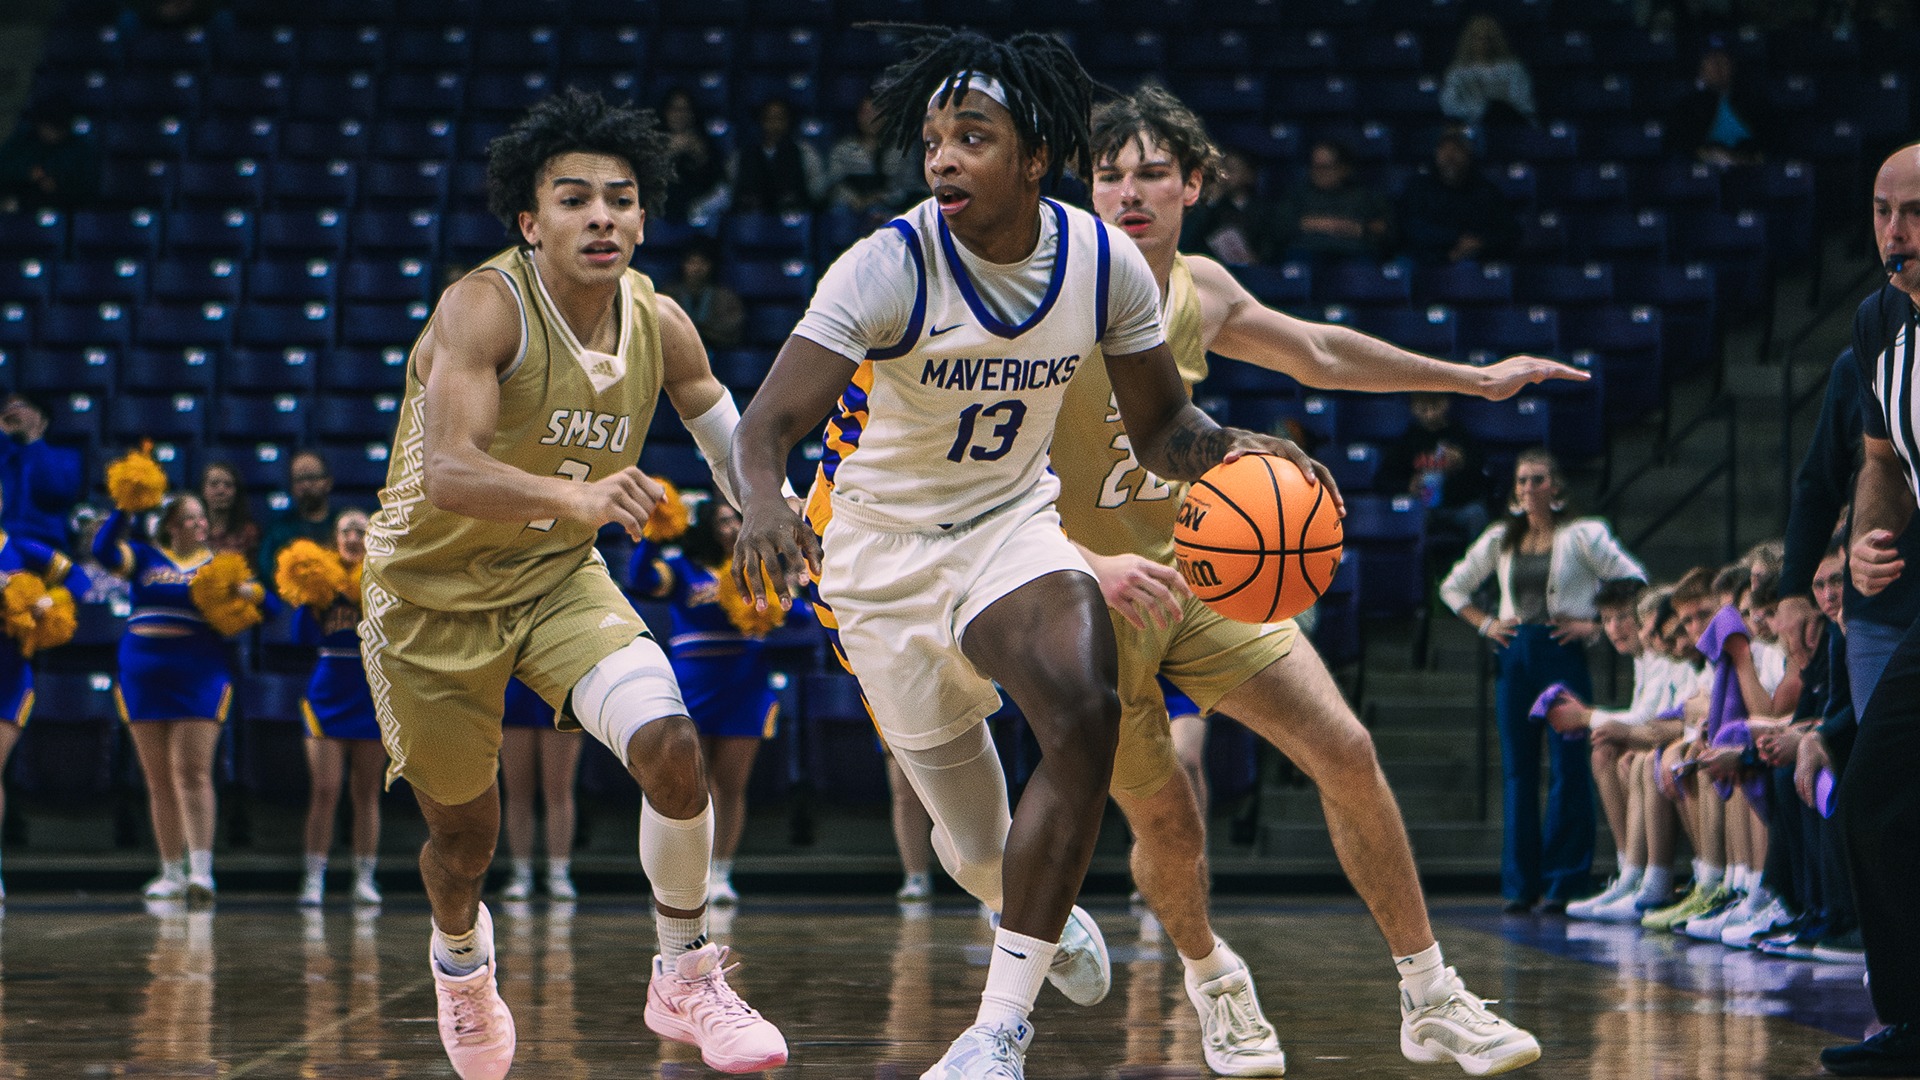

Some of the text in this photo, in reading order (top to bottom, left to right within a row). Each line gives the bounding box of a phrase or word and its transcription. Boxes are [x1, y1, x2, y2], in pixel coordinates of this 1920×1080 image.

[920, 354, 1079, 391] MAVERICKS
[540, 408, 629, 453] SMSU
[947, 399, 1027, 463] 13
